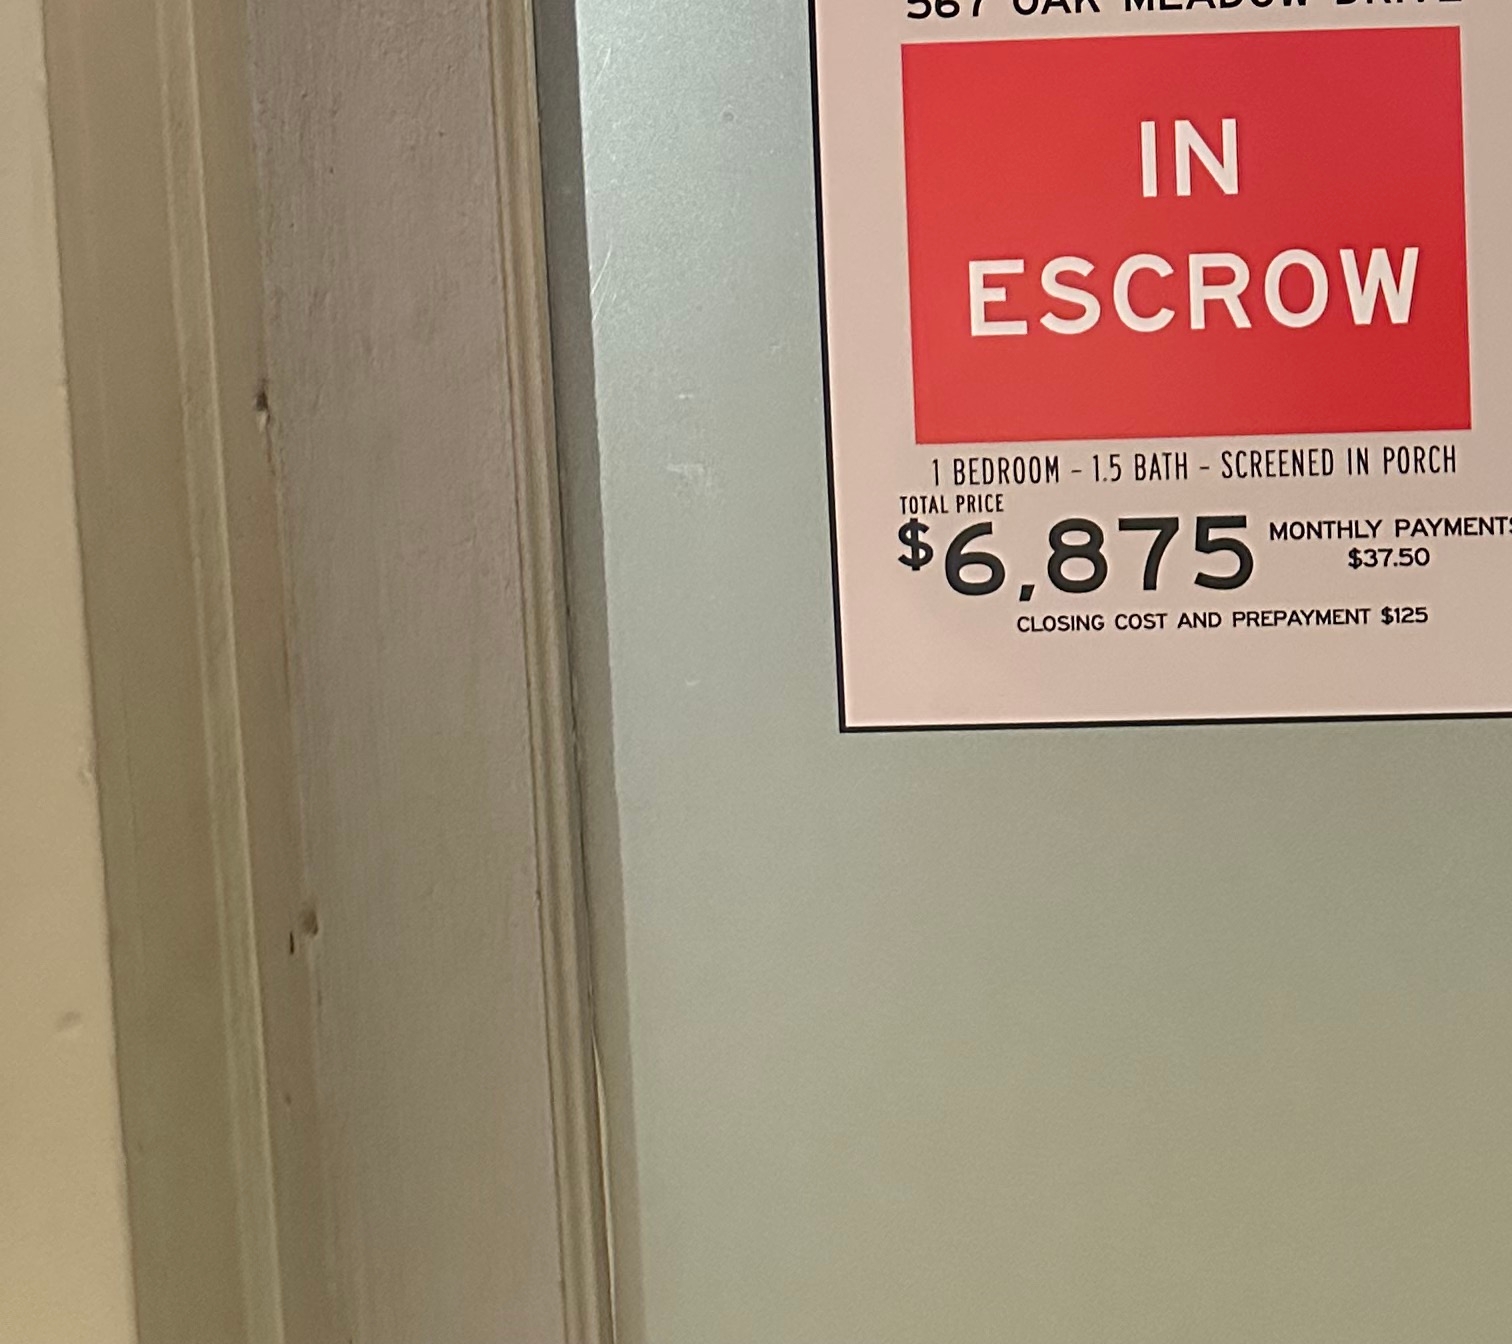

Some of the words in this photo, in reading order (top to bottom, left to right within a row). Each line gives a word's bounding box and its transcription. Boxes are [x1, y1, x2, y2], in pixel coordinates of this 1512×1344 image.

[1140, 118, 1239, 198] IN
[968, 246, 1419, 337] ESCROW
[932, 458, 939, 487] 1
[953, 455, 1060, 486] BEDROOM
[1092, 453, 1122, 483] 1.5
[1134, 451, 1188, 482] BATH
[1221, 447, 1334, 479] SCREENED
[1347, 447, 1369, 476] IN
[1383, 444, 1456, 475] PORCH
[899, 494, 949, 515] TOTAL
[955, 493, 1004, 514] PRICE
[1269, 519, 1383, 541] MONTHLY
[897, 514, 1254, 602] $6,875
[1348, 547, 1431, 570] $37.50
[1016, 614, 1105, 633] CLOSING
[1114, 612, 1168, 631] COST
[1177, 611, 1222, 629] AND
[1232, 607, 1371, 628] PREPAYMENT
[1380, 605, 1429, 626] $125
